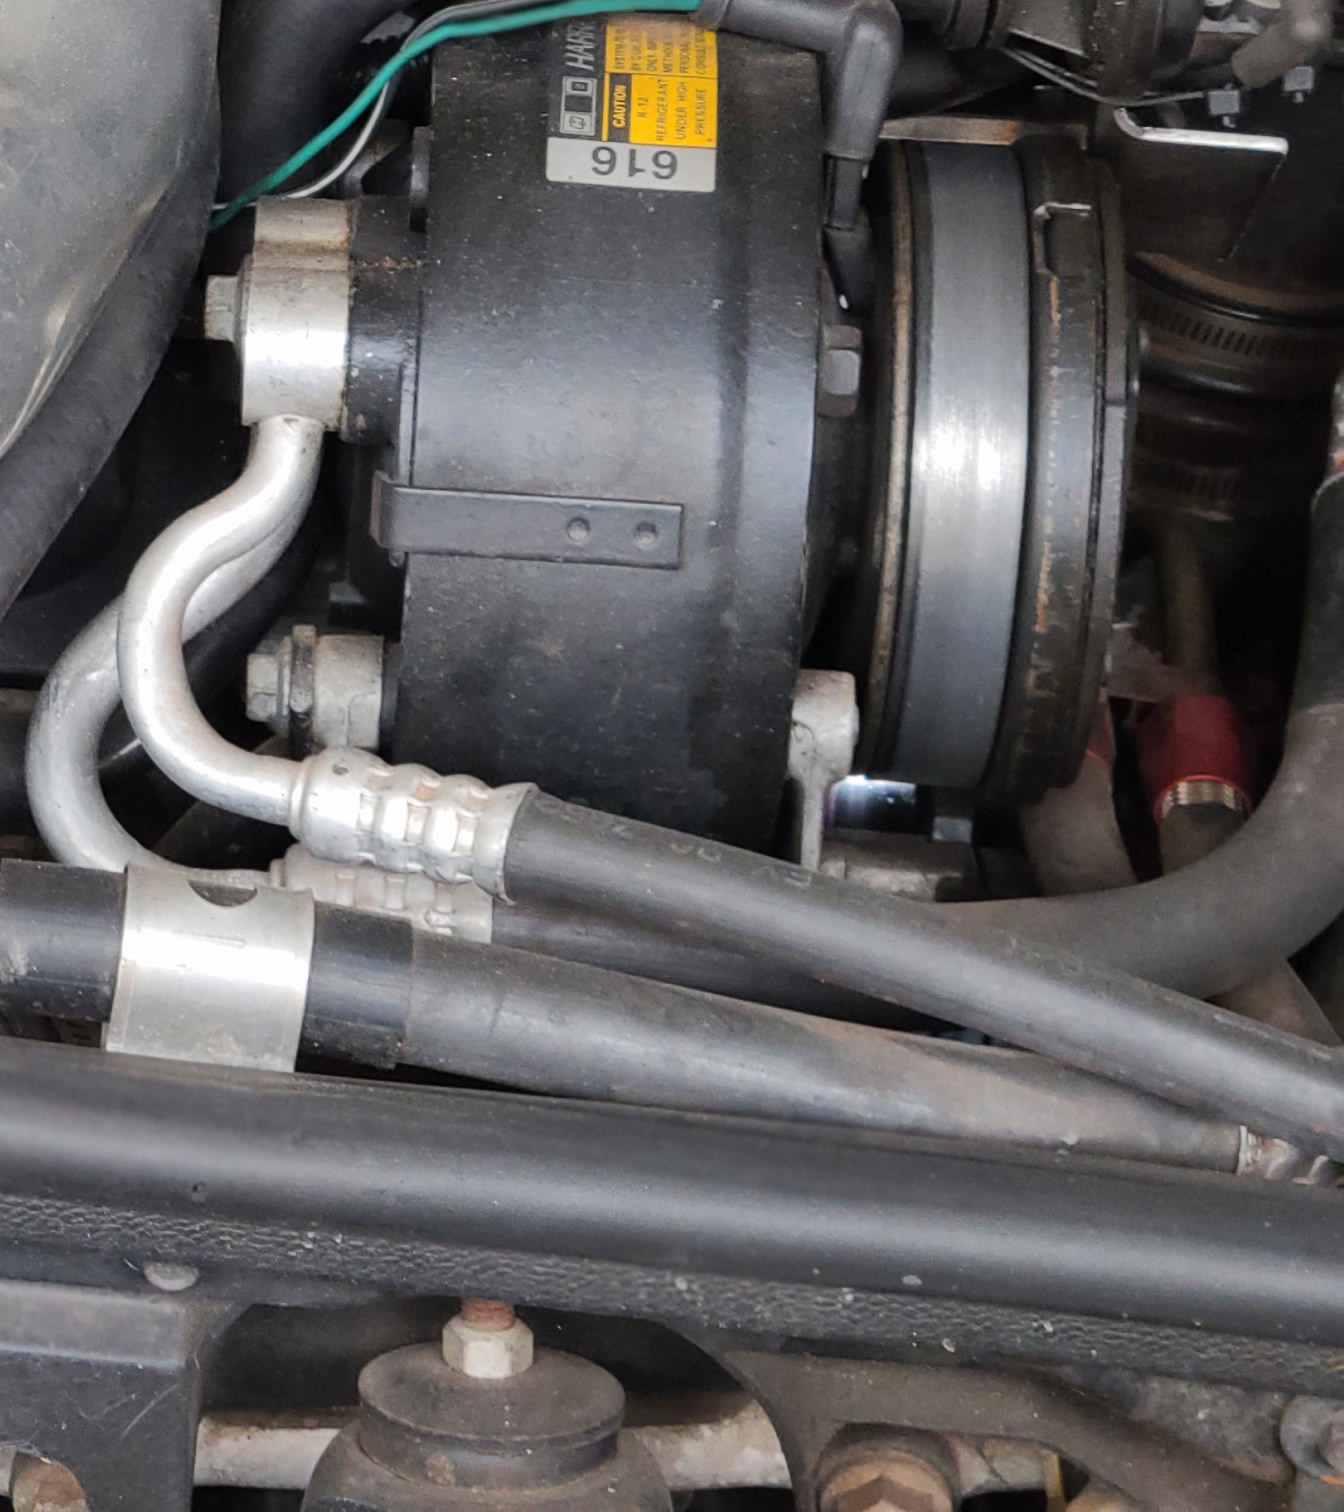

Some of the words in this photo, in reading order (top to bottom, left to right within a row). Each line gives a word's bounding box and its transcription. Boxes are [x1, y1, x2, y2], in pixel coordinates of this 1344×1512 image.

[612, 84, 628, 128] CAUTION
[655, 78, 668, 142] REFRIGERANT
[675, 80, 689, 102] HIGH
[675, 107, 689, 140] UNDER
[693, 88, 708, 135] PRESSURE
[590, 145, 679, 180] 616
